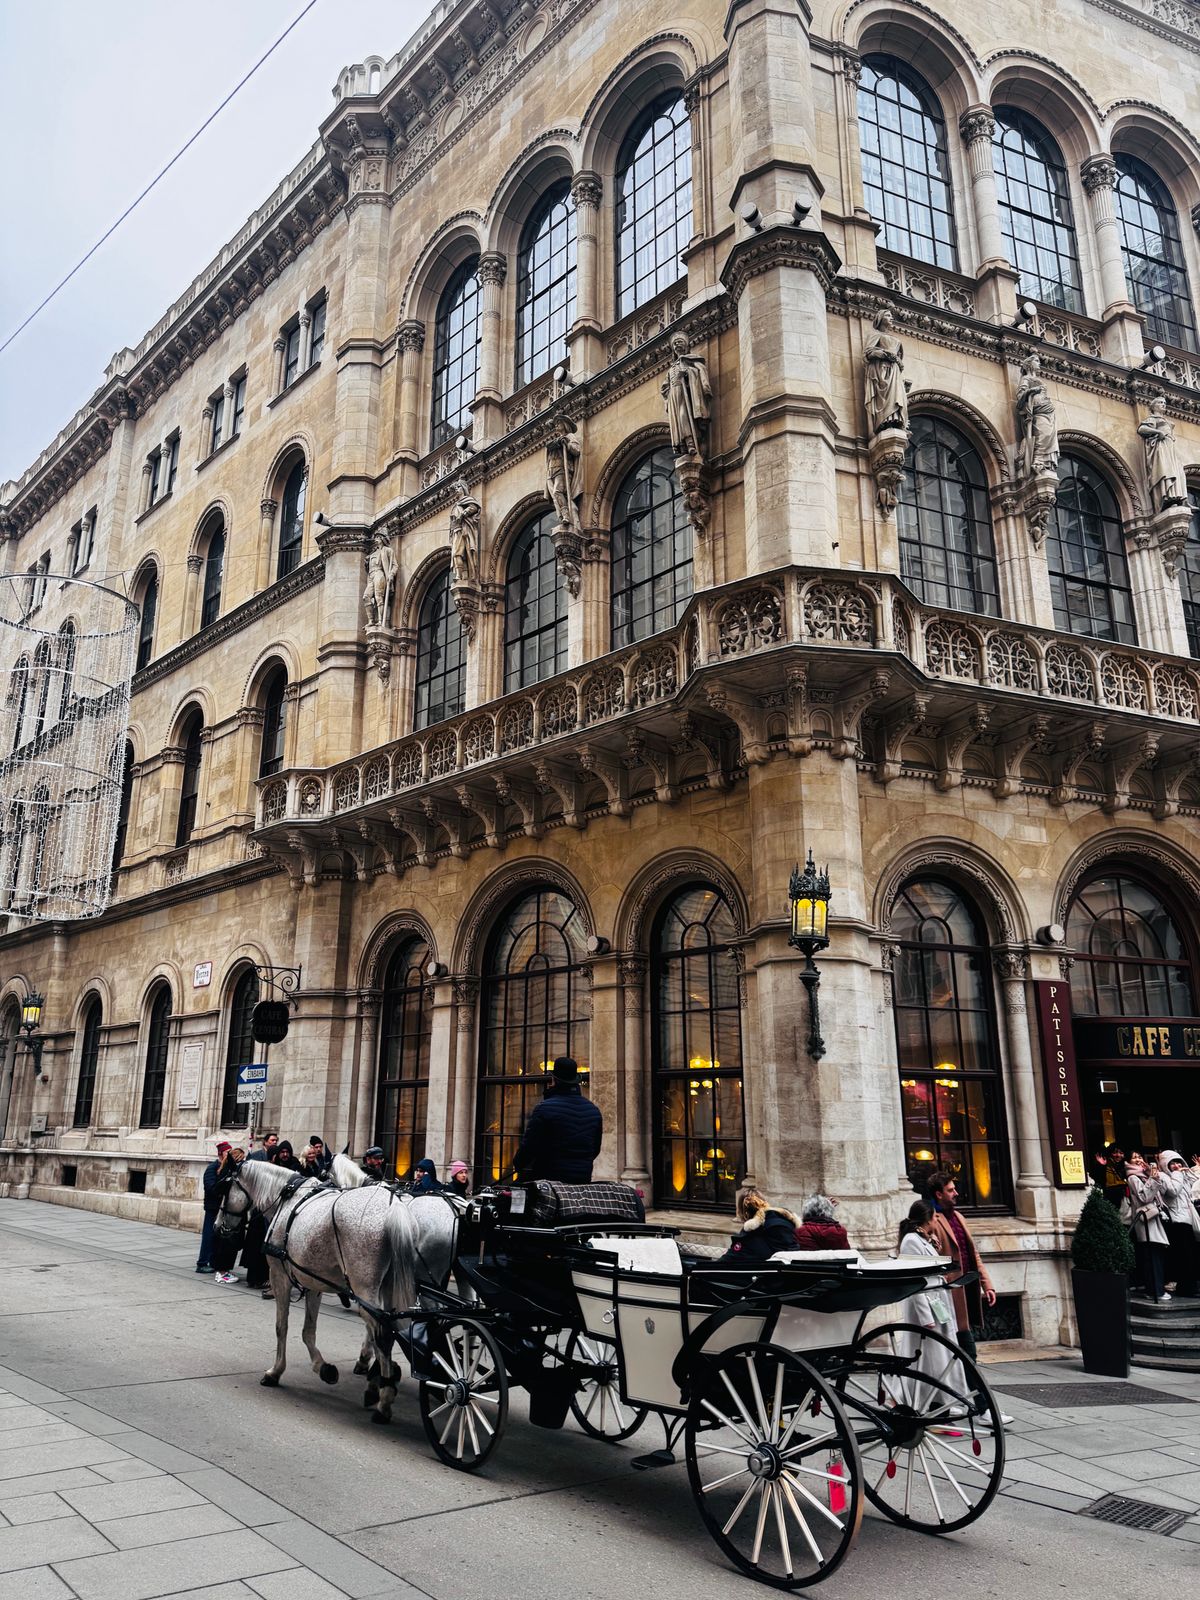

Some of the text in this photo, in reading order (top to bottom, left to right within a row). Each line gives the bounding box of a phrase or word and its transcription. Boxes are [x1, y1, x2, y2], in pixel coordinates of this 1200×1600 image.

[1116, 1026, 1172, 1056] CAFE
[247, 1069, 264, 1079] EINBAHN
[1050, 986, 1074, 1146] PATISSERIE
